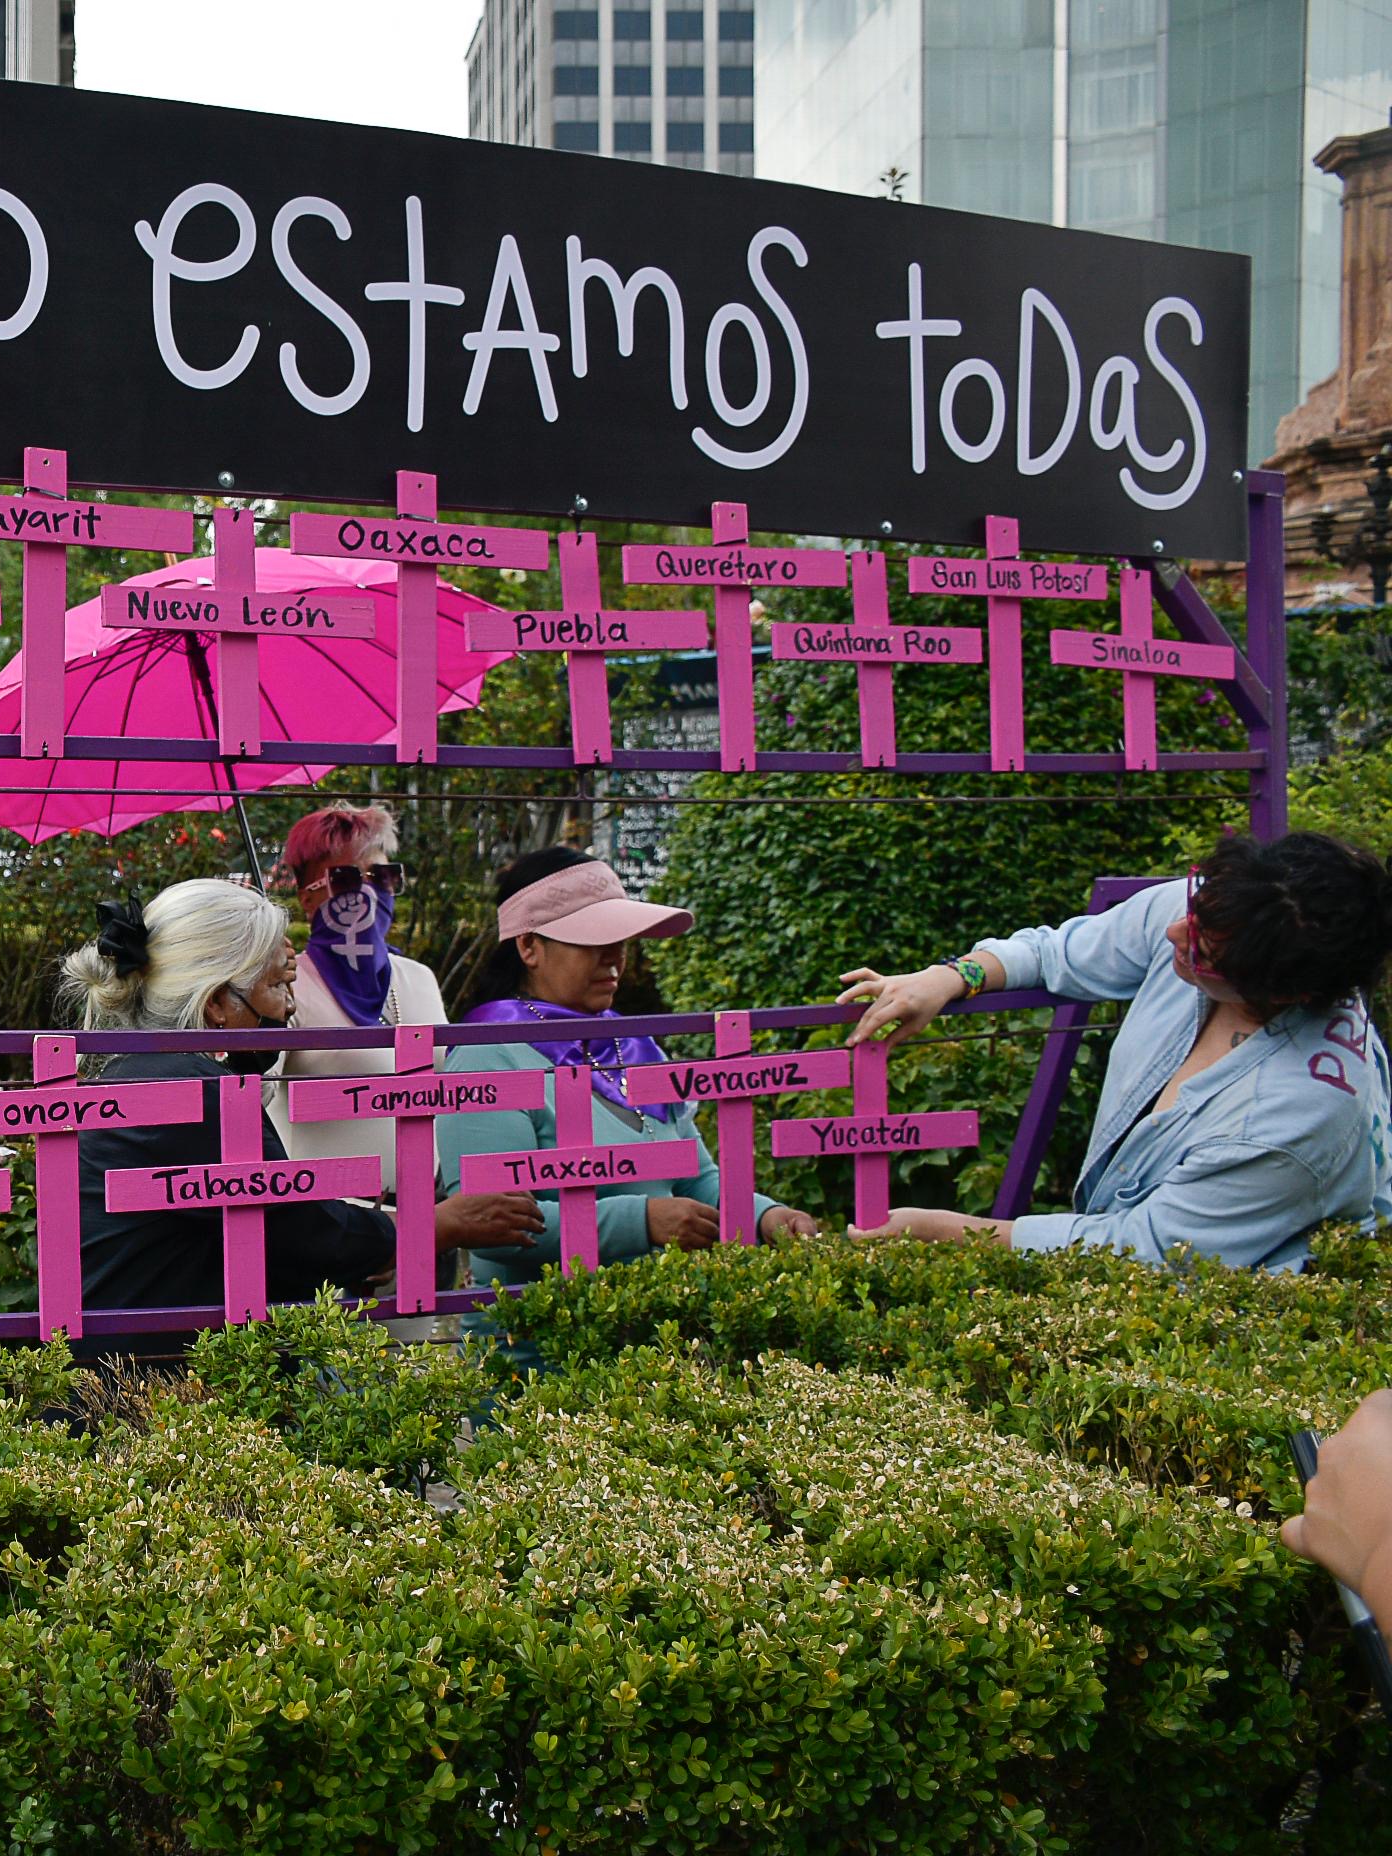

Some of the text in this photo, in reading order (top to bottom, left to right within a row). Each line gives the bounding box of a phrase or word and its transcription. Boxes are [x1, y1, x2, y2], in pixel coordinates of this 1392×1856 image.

[337, 519, 495, 560] Oaxaca
[656, 550, 798, 580] Querétaro
[931, 561, 1094, 594] San Luis Potosí
[127, 590, 336, 629] Nuevo León
[515, 613, 629, 647] Puebla
[794, 627, 952, 657] Quintana Roo
[1091, 636, 1182, 667] Sinaloa
[342, 1080, 499, 1113] Tamaulipas
[668, 1063, 809, 1100] Veracruz
[810, 1119, 921, 1152] Yucatán
[504, 1150, 638, 1187] Tlaxcala
[151, 1167, 317, 1205] Tabasco
